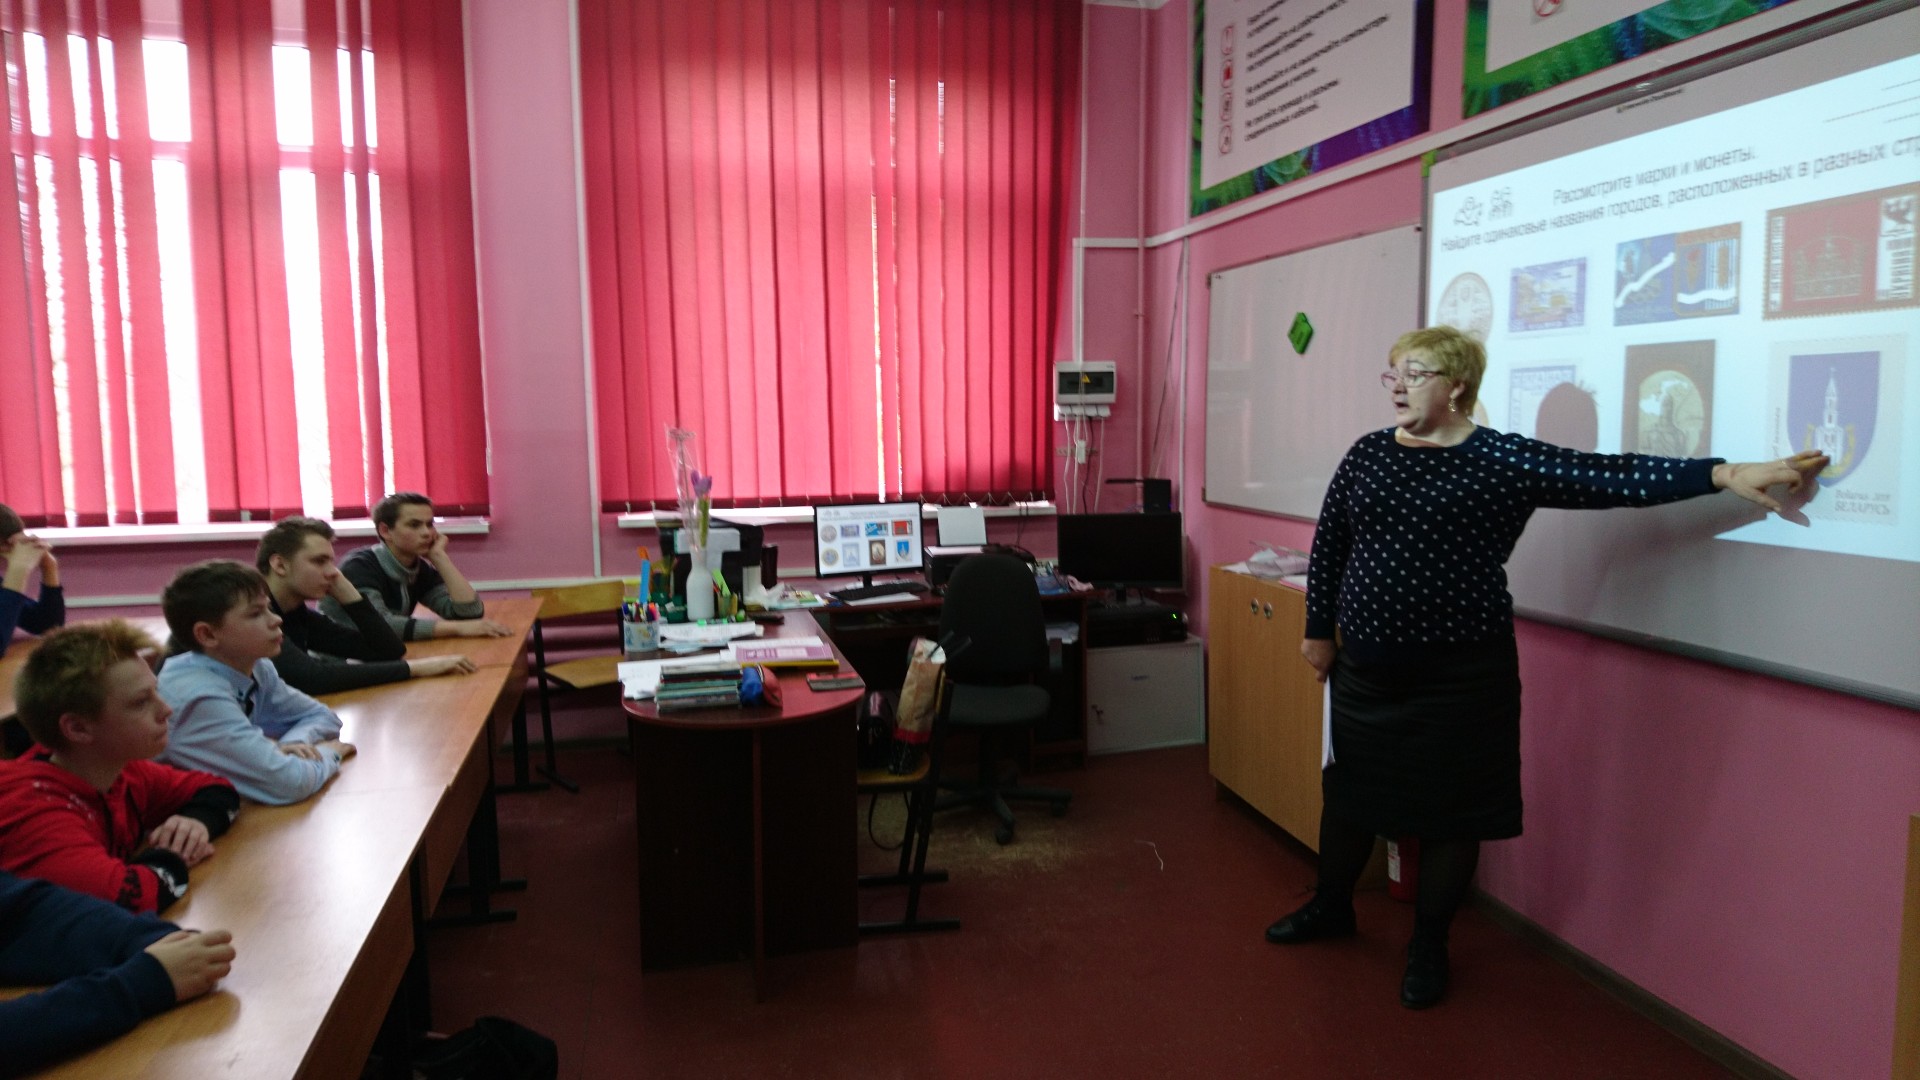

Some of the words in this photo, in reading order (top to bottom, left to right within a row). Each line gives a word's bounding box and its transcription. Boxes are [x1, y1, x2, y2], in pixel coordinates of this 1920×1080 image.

[1441, 232, 1481, 252] Найдите
[1484, 218, 1547, 245] одинаковые
[1550, 206, 1604, 228] названия
[1667, 165, 1793, 209] расположенных
[1798, 161, 1807, 177] в
[1813, 144, 1886, 178] разных
[1553, 175, 1631, 206] Рассмотрите
[1636, 165, 1677, 188] марки
[1681, 160, 1689, 175] и
